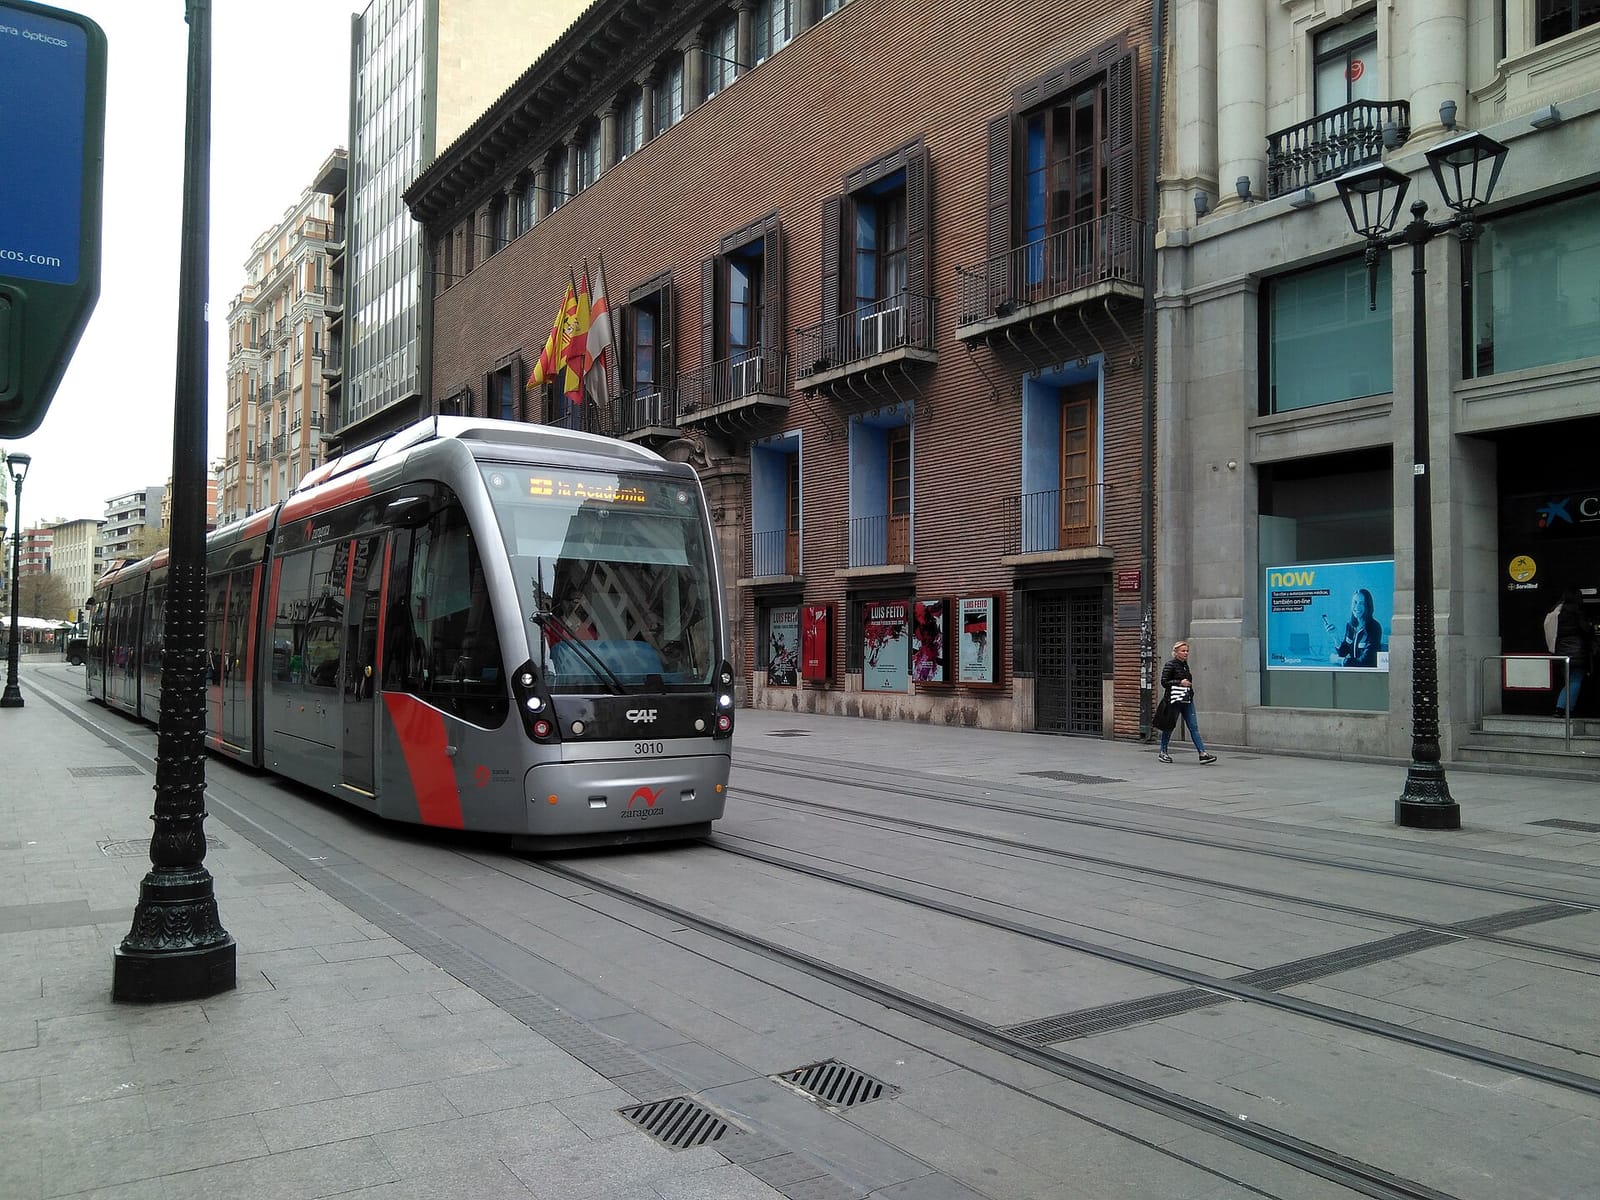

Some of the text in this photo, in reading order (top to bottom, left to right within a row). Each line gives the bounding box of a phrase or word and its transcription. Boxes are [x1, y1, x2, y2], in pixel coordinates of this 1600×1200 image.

[22, 29, 68, 48] ópticos
[0, 249, 61, 267] cos.com
[1270, 571, 1316, 587] now
[871, 605, 904, 619] LUIS FEITO
[626, 709, 657, 723] CAF
[634, 742, 664, 755] 3010
[620, 807, 665, 820] zaragoza
